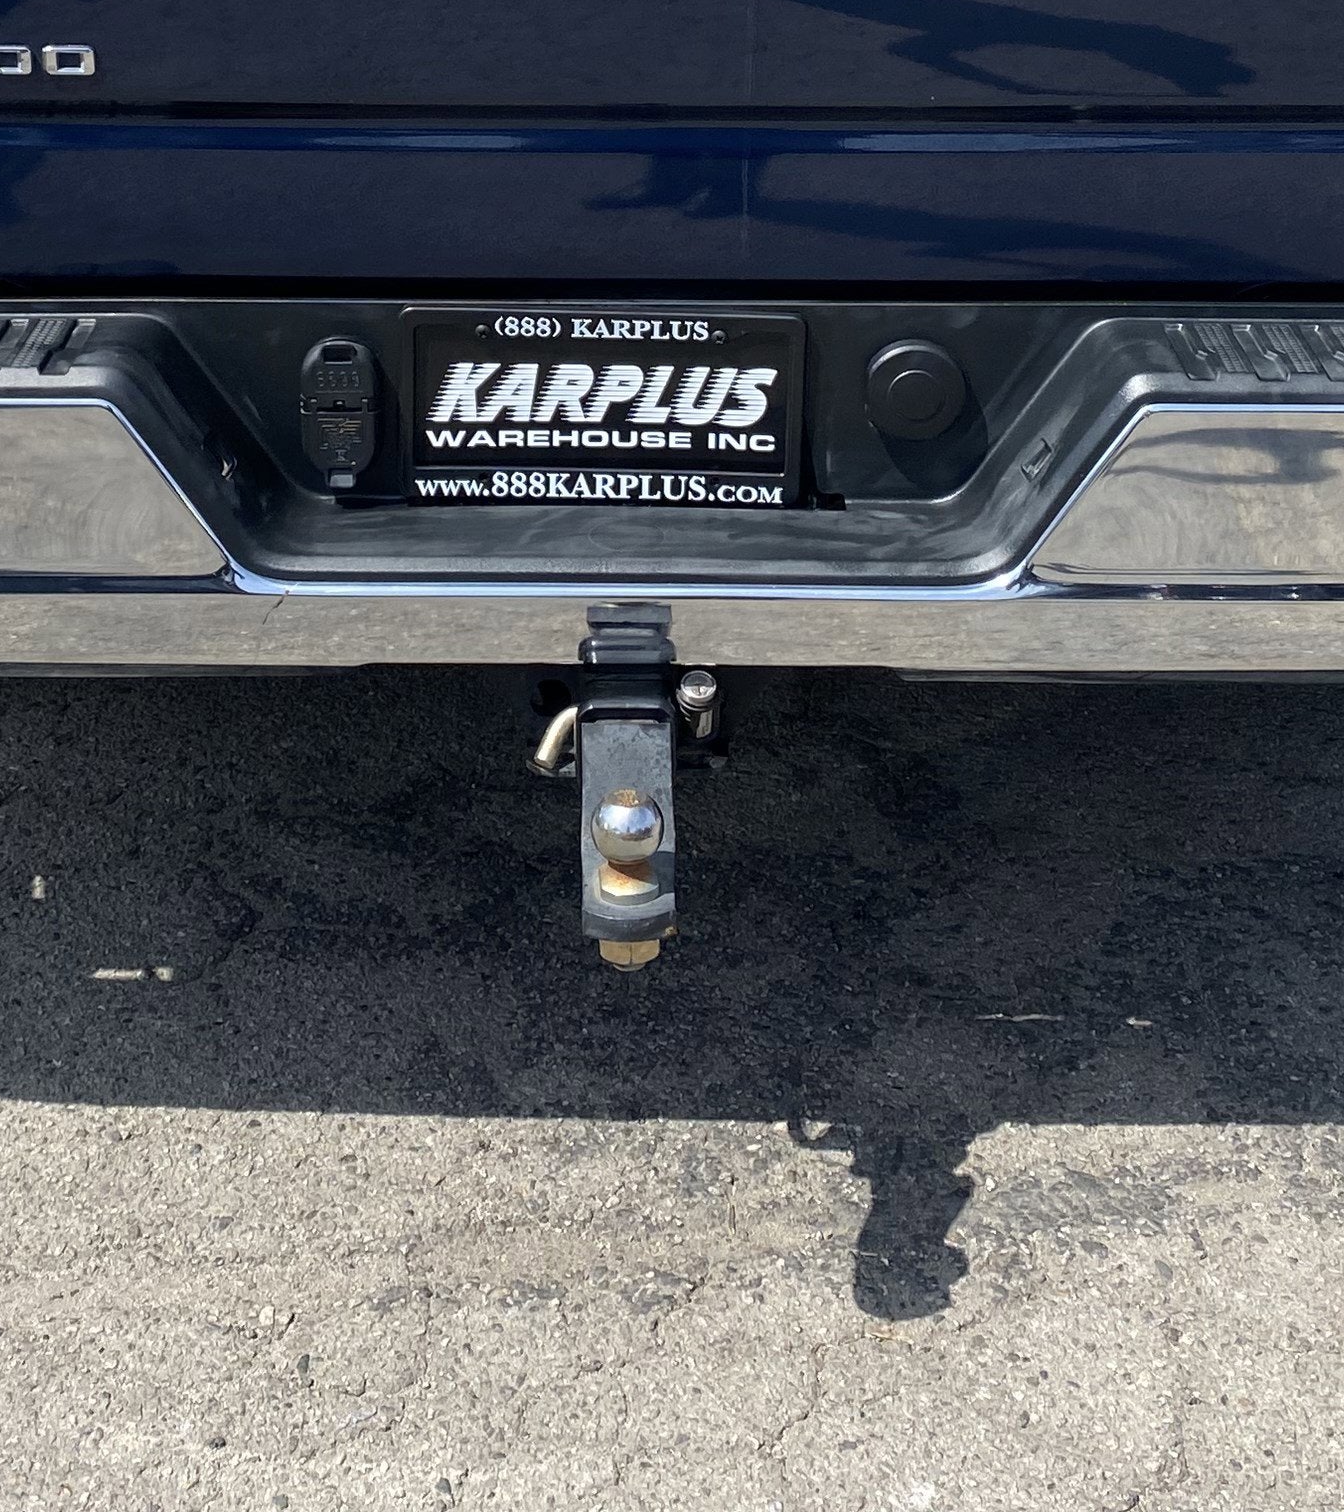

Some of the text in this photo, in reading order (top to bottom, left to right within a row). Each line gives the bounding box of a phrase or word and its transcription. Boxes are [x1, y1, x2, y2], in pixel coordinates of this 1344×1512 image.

[493, 316, 710, 342] (888) KARPLUS
[424, 361, 778, 428] KARPLUS
[425, 429, 776, 453] WAREHOUSE INC
